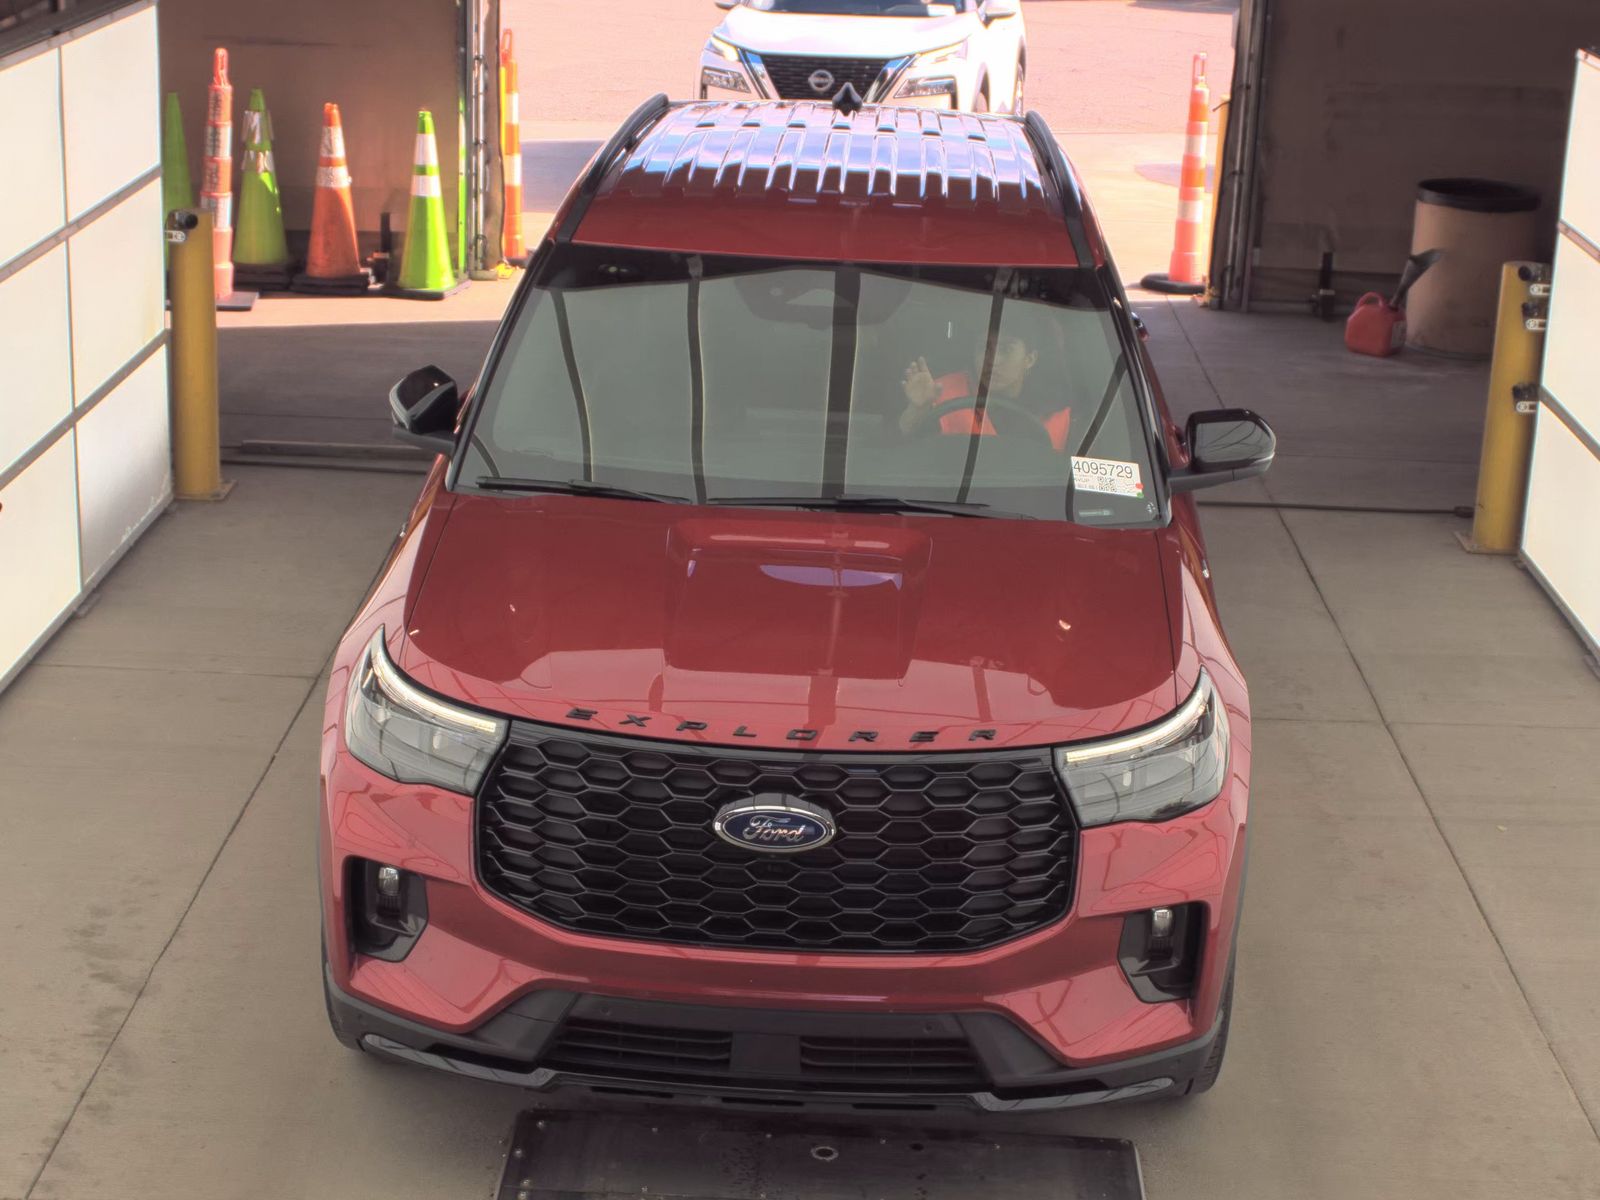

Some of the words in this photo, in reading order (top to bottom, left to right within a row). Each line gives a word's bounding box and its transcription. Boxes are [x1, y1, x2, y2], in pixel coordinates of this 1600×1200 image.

[1074, 460, 1133, 479] 4095729
[565, 707, 997, 743] EXPLORER
[742, 814, 806, 842] Ford
